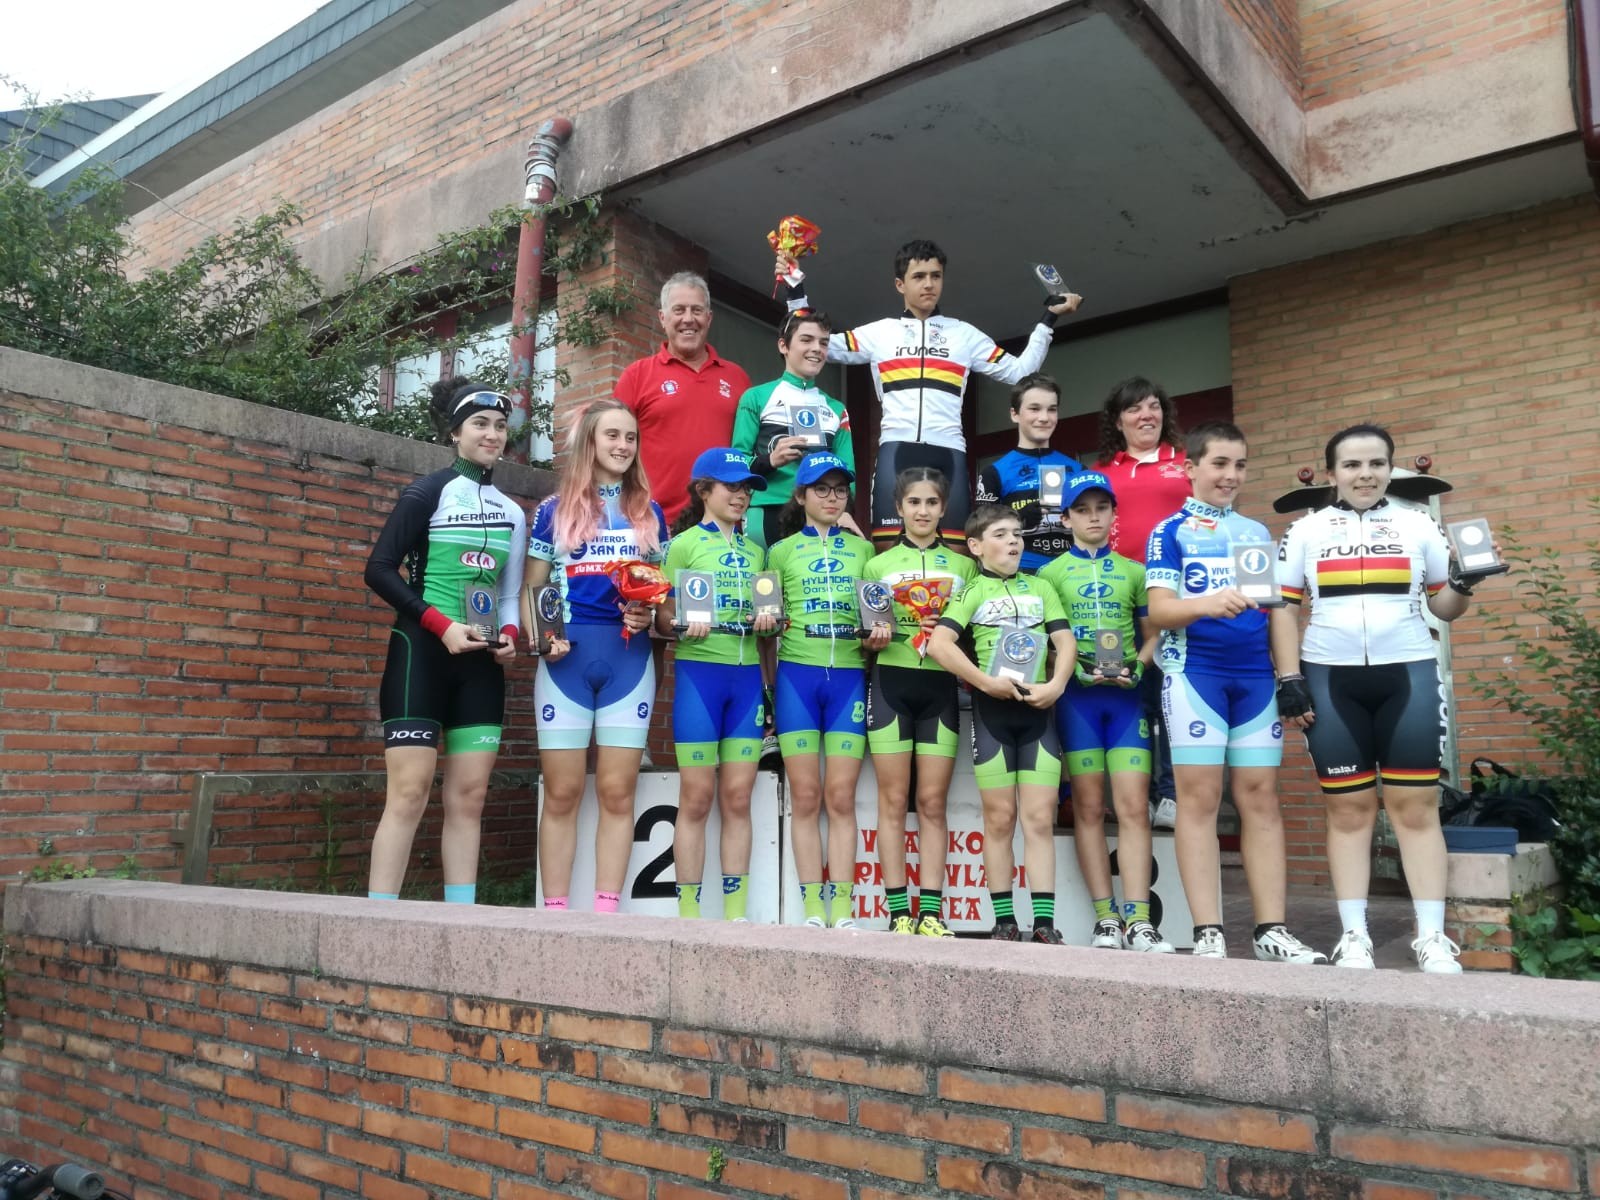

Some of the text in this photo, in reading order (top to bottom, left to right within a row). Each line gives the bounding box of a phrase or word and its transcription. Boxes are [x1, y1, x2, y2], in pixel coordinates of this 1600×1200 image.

[895, 346, 950, 358] irunes
[447, 512, 506, 522] HERNANI
[590, 545, 615, 556] SAN
[1320, 543, 1404, 559] irunes
[387, 730, 433, 740] JOCC
[1327, 764, 1358, 775] kalas
[632, 803, 677, 899] 2
